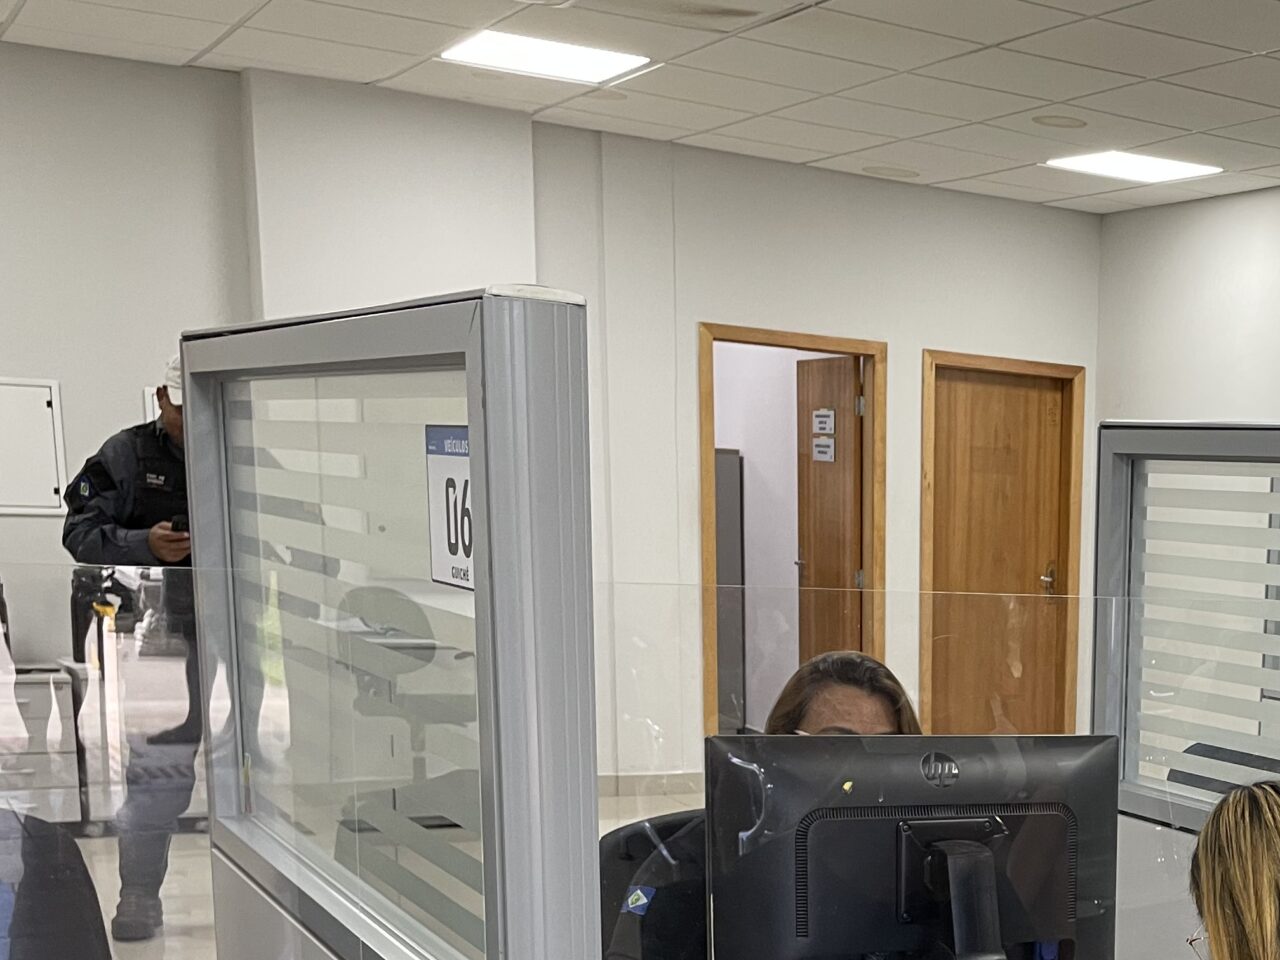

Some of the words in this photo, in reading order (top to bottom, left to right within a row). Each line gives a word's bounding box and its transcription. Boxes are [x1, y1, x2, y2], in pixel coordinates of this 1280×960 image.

[444, 436, 469, 453] VEÍCULOS
[445, 477, 472, 559] 06
[926, 752, 959, 788] hp
